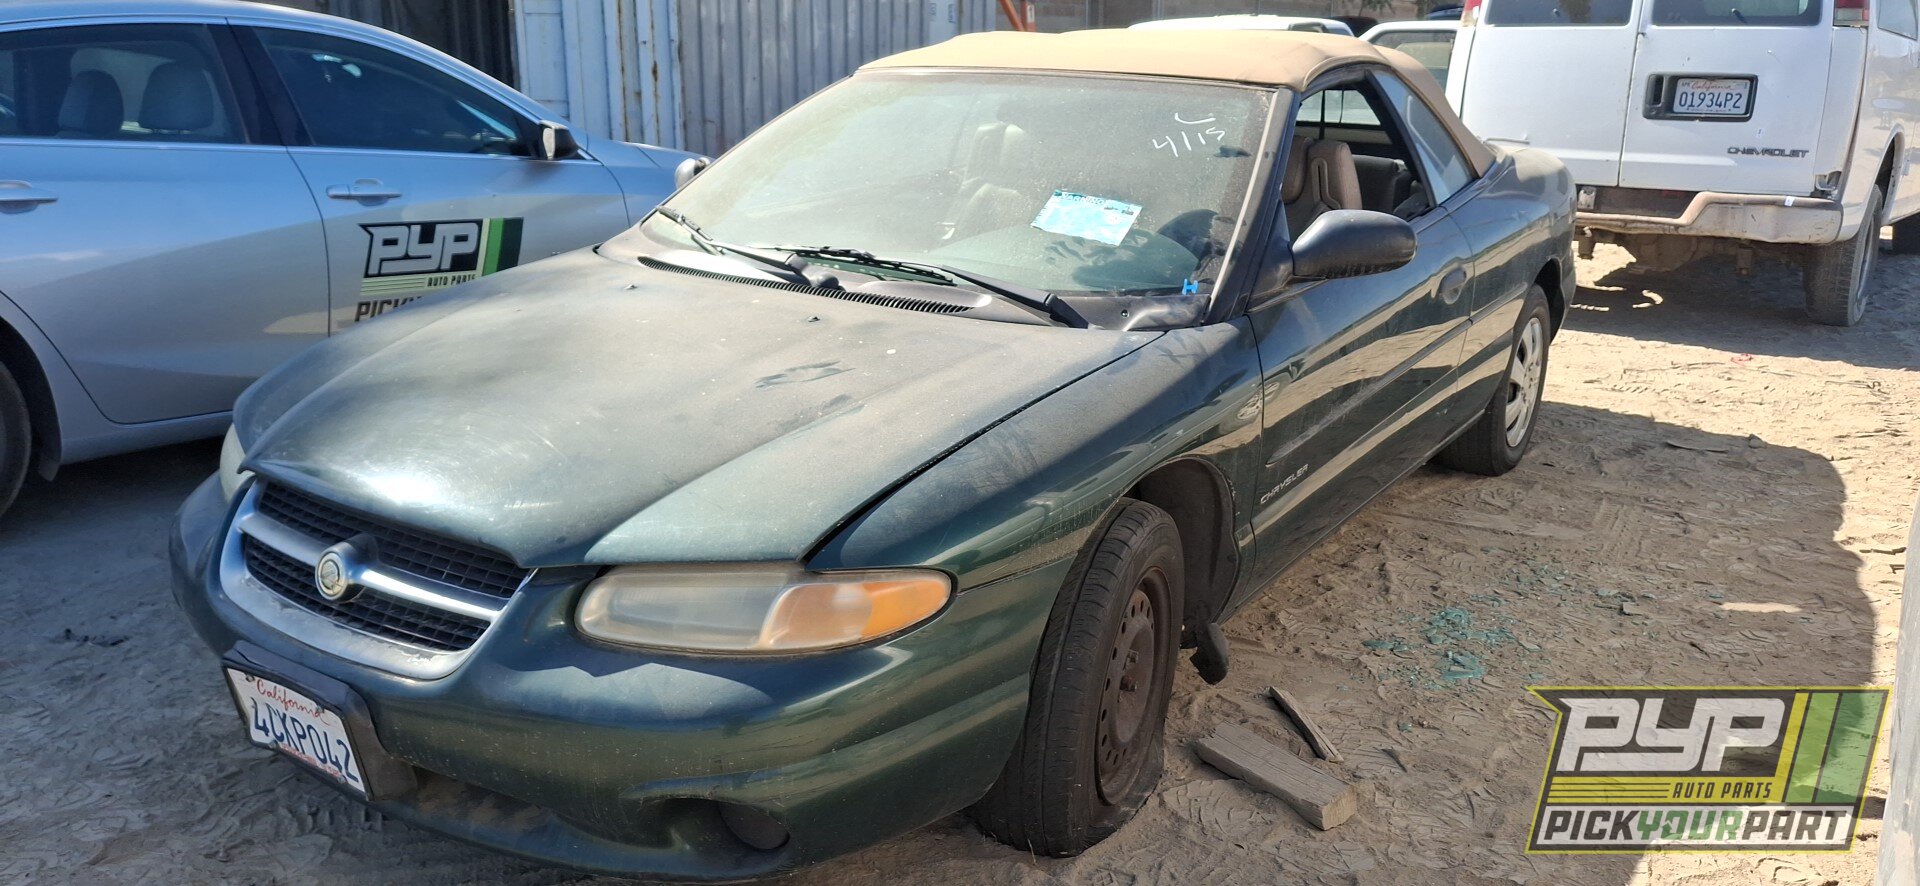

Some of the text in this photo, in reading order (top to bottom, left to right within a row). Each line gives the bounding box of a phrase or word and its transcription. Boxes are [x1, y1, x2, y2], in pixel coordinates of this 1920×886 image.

[1678, 91, 1743, 109] 01934P2
[1727, 147, 1810, 158] CHEVROLET
[365, 222, 480, 276] PYP
[427, 275, 449, 287] AUTO
[1260, 463, 1309, 505] CHRYSLER
[256, 678, 329, 722] California
[250, 696, 360, 784] 4CXP042
